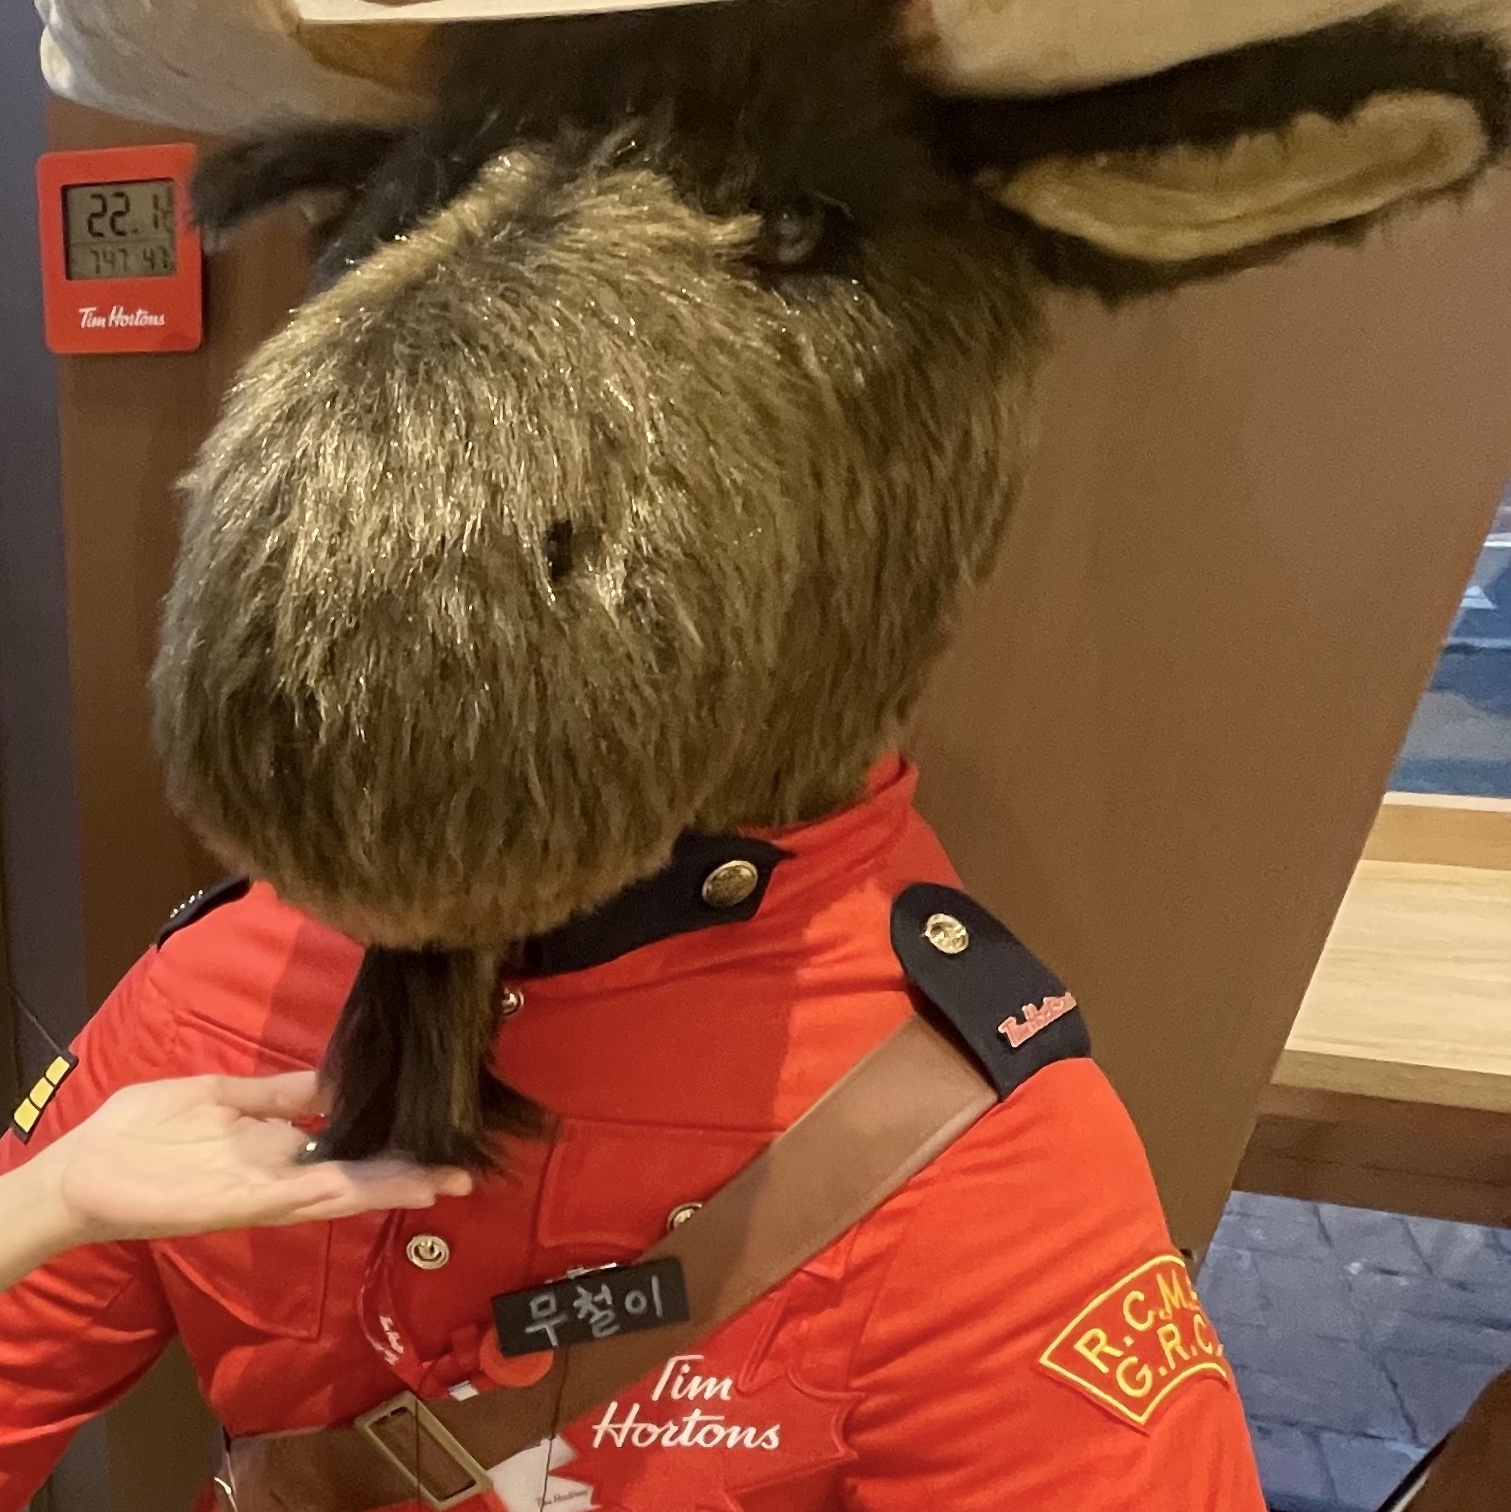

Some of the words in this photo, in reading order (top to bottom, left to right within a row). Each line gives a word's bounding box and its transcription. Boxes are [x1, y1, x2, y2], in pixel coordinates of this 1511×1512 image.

[78, 306, 107, 329] Tim
[107, 304, 166, 328] Hortons
[524, 1274, 663, 1347] 무철이
[650, 1353, 736, 1402] Tim
[591, 1400, 783, 1450] Hortons
